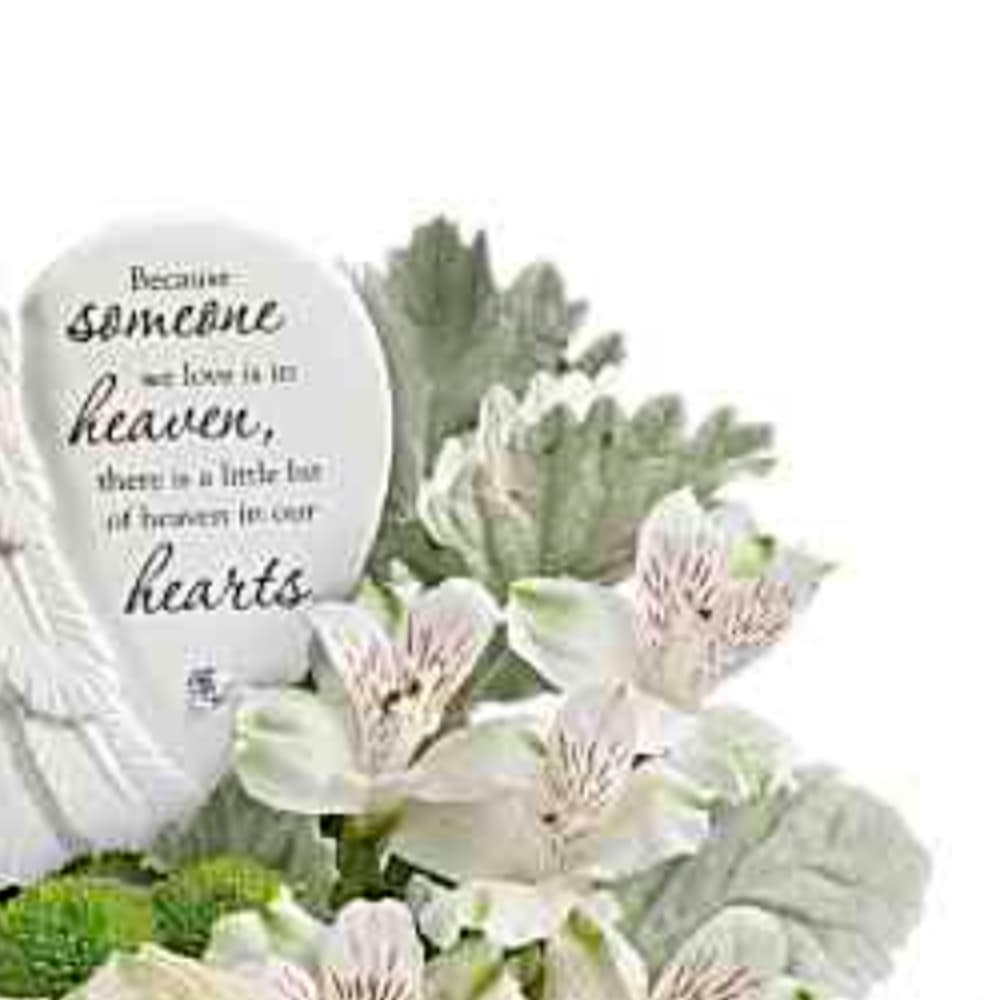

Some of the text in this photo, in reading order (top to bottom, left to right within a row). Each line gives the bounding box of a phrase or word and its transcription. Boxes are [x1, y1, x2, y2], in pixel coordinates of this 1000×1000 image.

[129, 265, 234, 292] Because
[65, 299, 284, 343] someone
[182, 361, 233, 387] love
[243, 364, 261, 386] is
[66, 372, 276, 448] heaven,
[96, 464, 164, 492] there
[171, 465, 192, 489] is
[200, 472, 214, 489] a
[222, 460, 279, 488] little
[107, 502, 315, 533] of heaven in our
[123, 540, 314, 616] hearts
